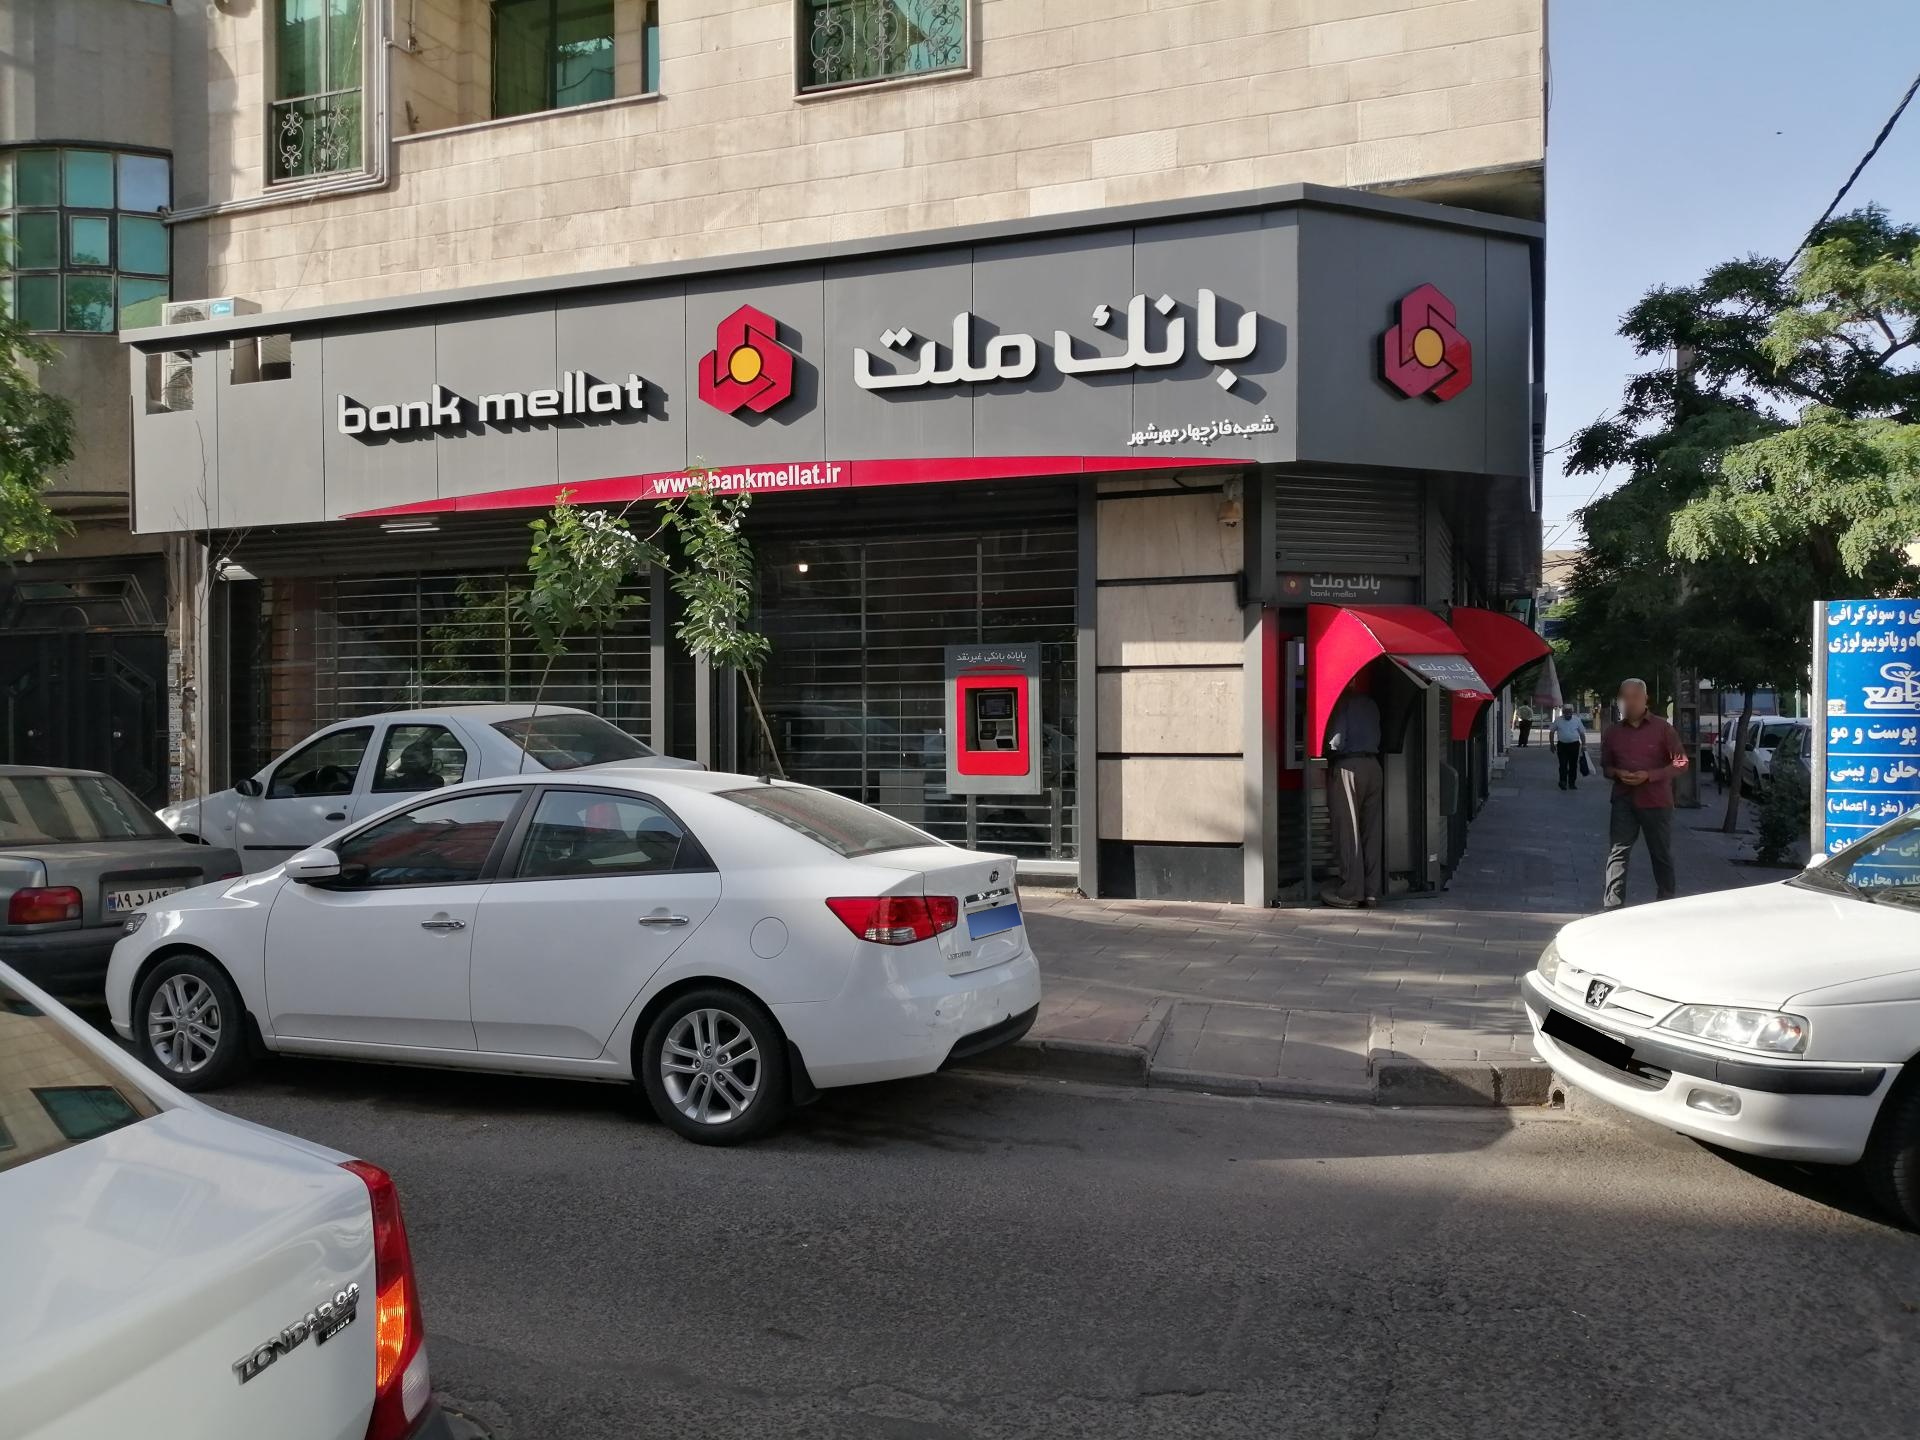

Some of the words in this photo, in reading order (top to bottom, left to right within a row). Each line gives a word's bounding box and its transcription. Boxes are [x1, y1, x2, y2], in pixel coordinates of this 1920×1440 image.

[853, 311, 1037, 390] ملت
[337, 384, 460, 434] bank
[478, 370, 644, 421] mellat
[1178, 423, 1210, 445] چهار
[1209, 419, 1232, 439] فاز
[1233, 414, 1275, 438] شعبه
[653, 462, 842, 494] wwwbankmellat.ir
[1310, 573, 1345, 588] ملت
[1310, 589, 1330, 597] bank
[1827, 603, 1895, 626] سونوگرافی
[1897, 610, 1906, 625] و
[1828, 631, 1899, 653] پاتوبیولوژی
[984, 651, 1005, 663] بانکی
[1006, 651, 1027, 663] پایانه
[1829, 726, 1849, 745] مو
[1852, 727, 1863, 745] و
[1867, 724, 1917, 746] پوست
[1868, 767, 1879, 784] و
[1868, 804, 1876, 816] و
